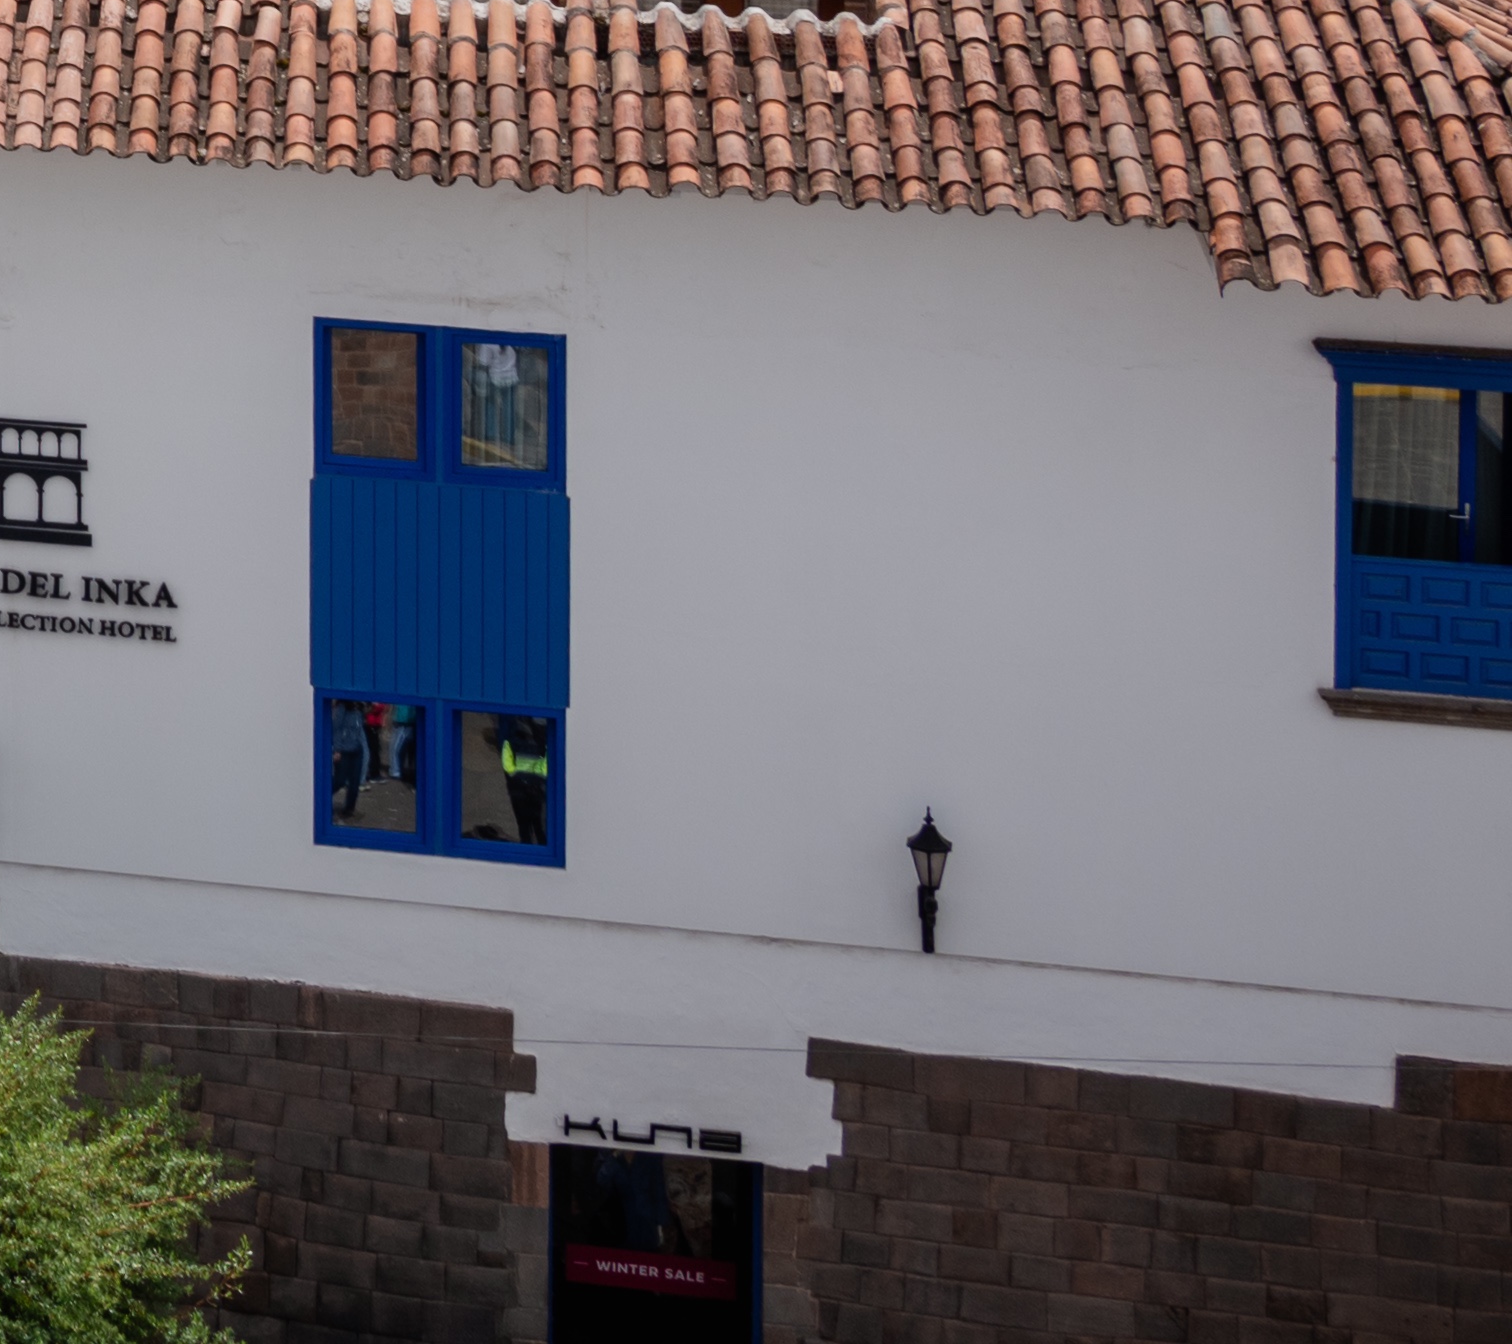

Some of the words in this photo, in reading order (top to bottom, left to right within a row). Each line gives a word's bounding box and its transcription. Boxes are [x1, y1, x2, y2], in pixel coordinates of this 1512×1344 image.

[0, 568, 71, 600] DEL
[80, 575, 178, 609] INKA
[98, 620, 177, 643] HOTEL
[596, 1259, 659, 1278] WINTER
[664, 1267, 705, 1284] SALE
